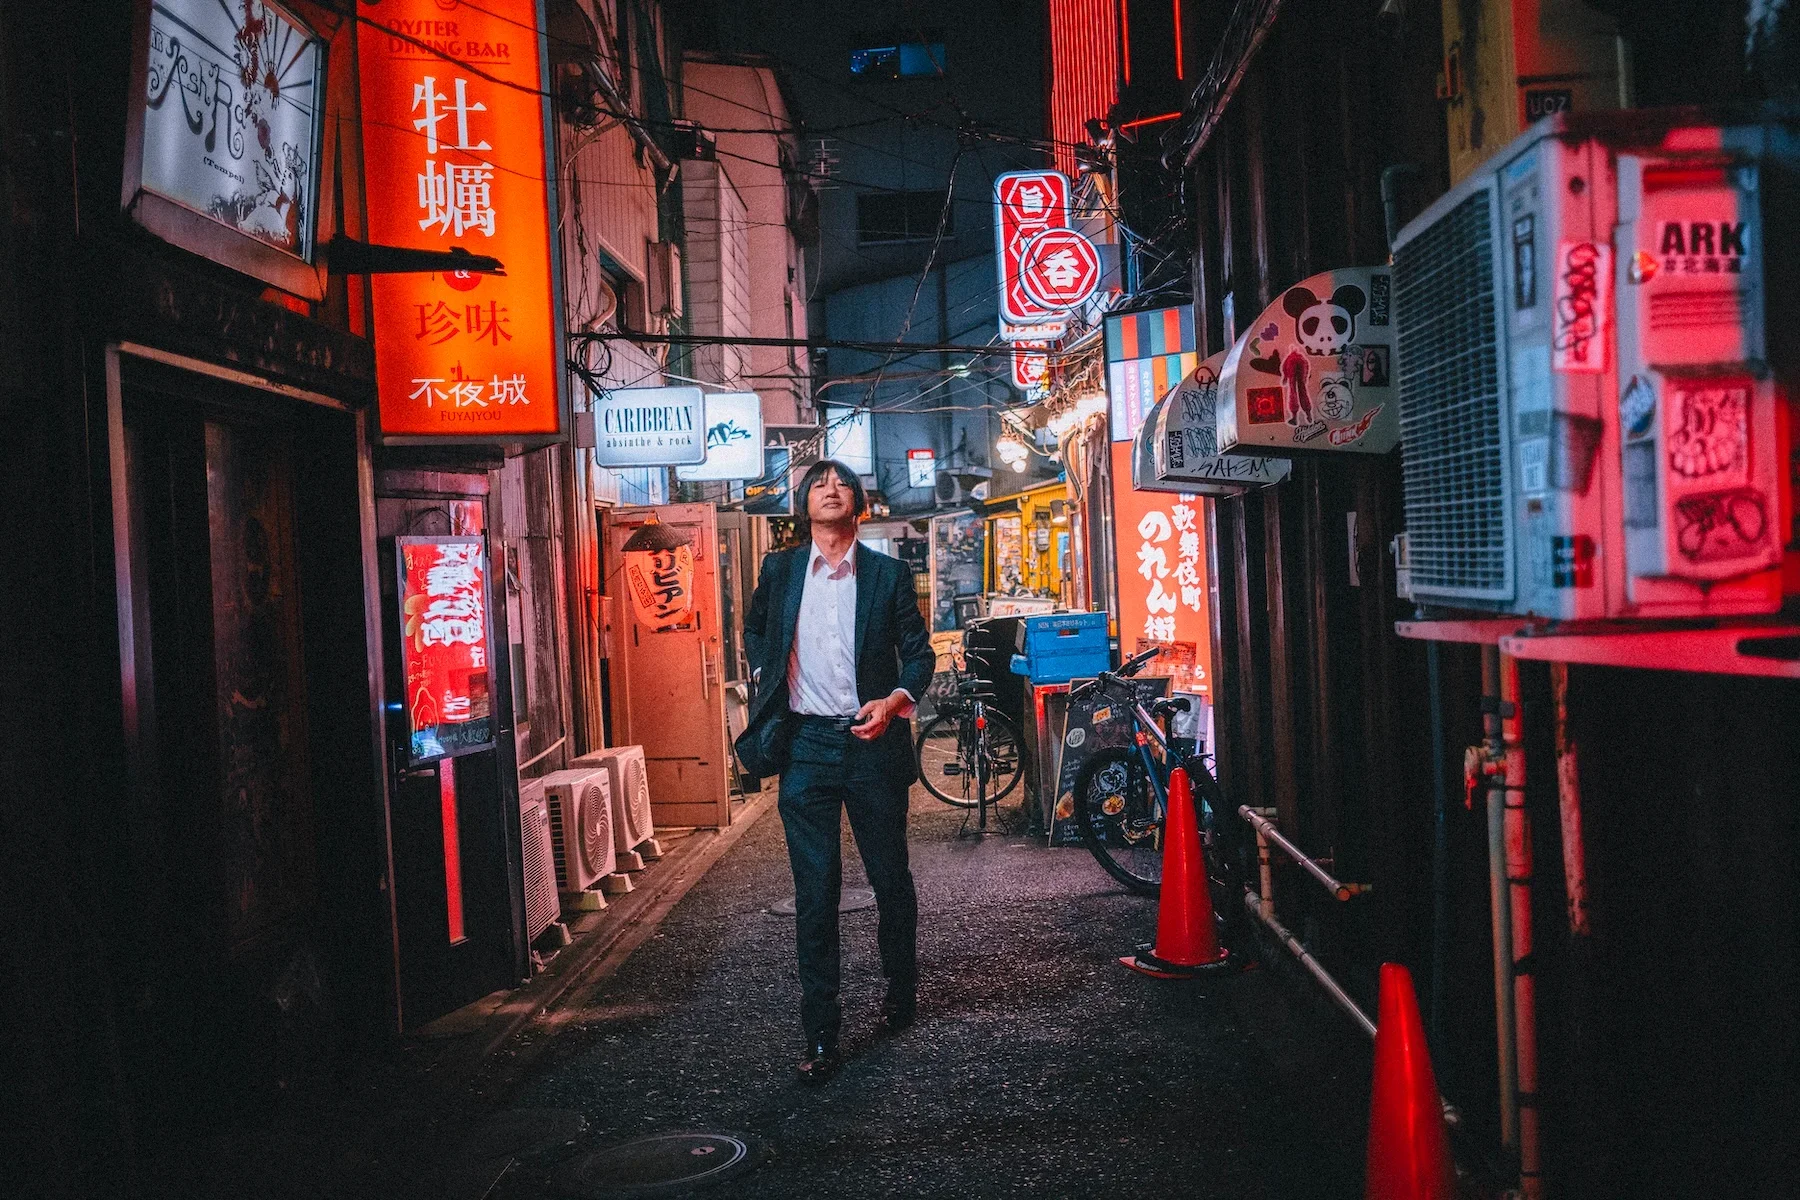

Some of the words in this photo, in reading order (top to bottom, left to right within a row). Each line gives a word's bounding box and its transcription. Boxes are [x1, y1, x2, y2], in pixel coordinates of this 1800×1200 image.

[387, 19, 460, 36] OYSTER
[466, 42, 510, 58] BAR
[411, 75, 497, 238] 牡蠣
[1660, 222, 1746, 255] ARK
[413, 300, 513, 347] 珍味
[408, 373, 531, 408] 不夜城
[440, 410, 501, 422] FUYAJYOU
[605, 406, 693, 434] CARIBBEAN
[606, 436, 651, 448] absinthe
[657, 436, 663, 446] &
[669, 435, 692, 446] rock
[1136, 511, 1177, 645] のれん街
